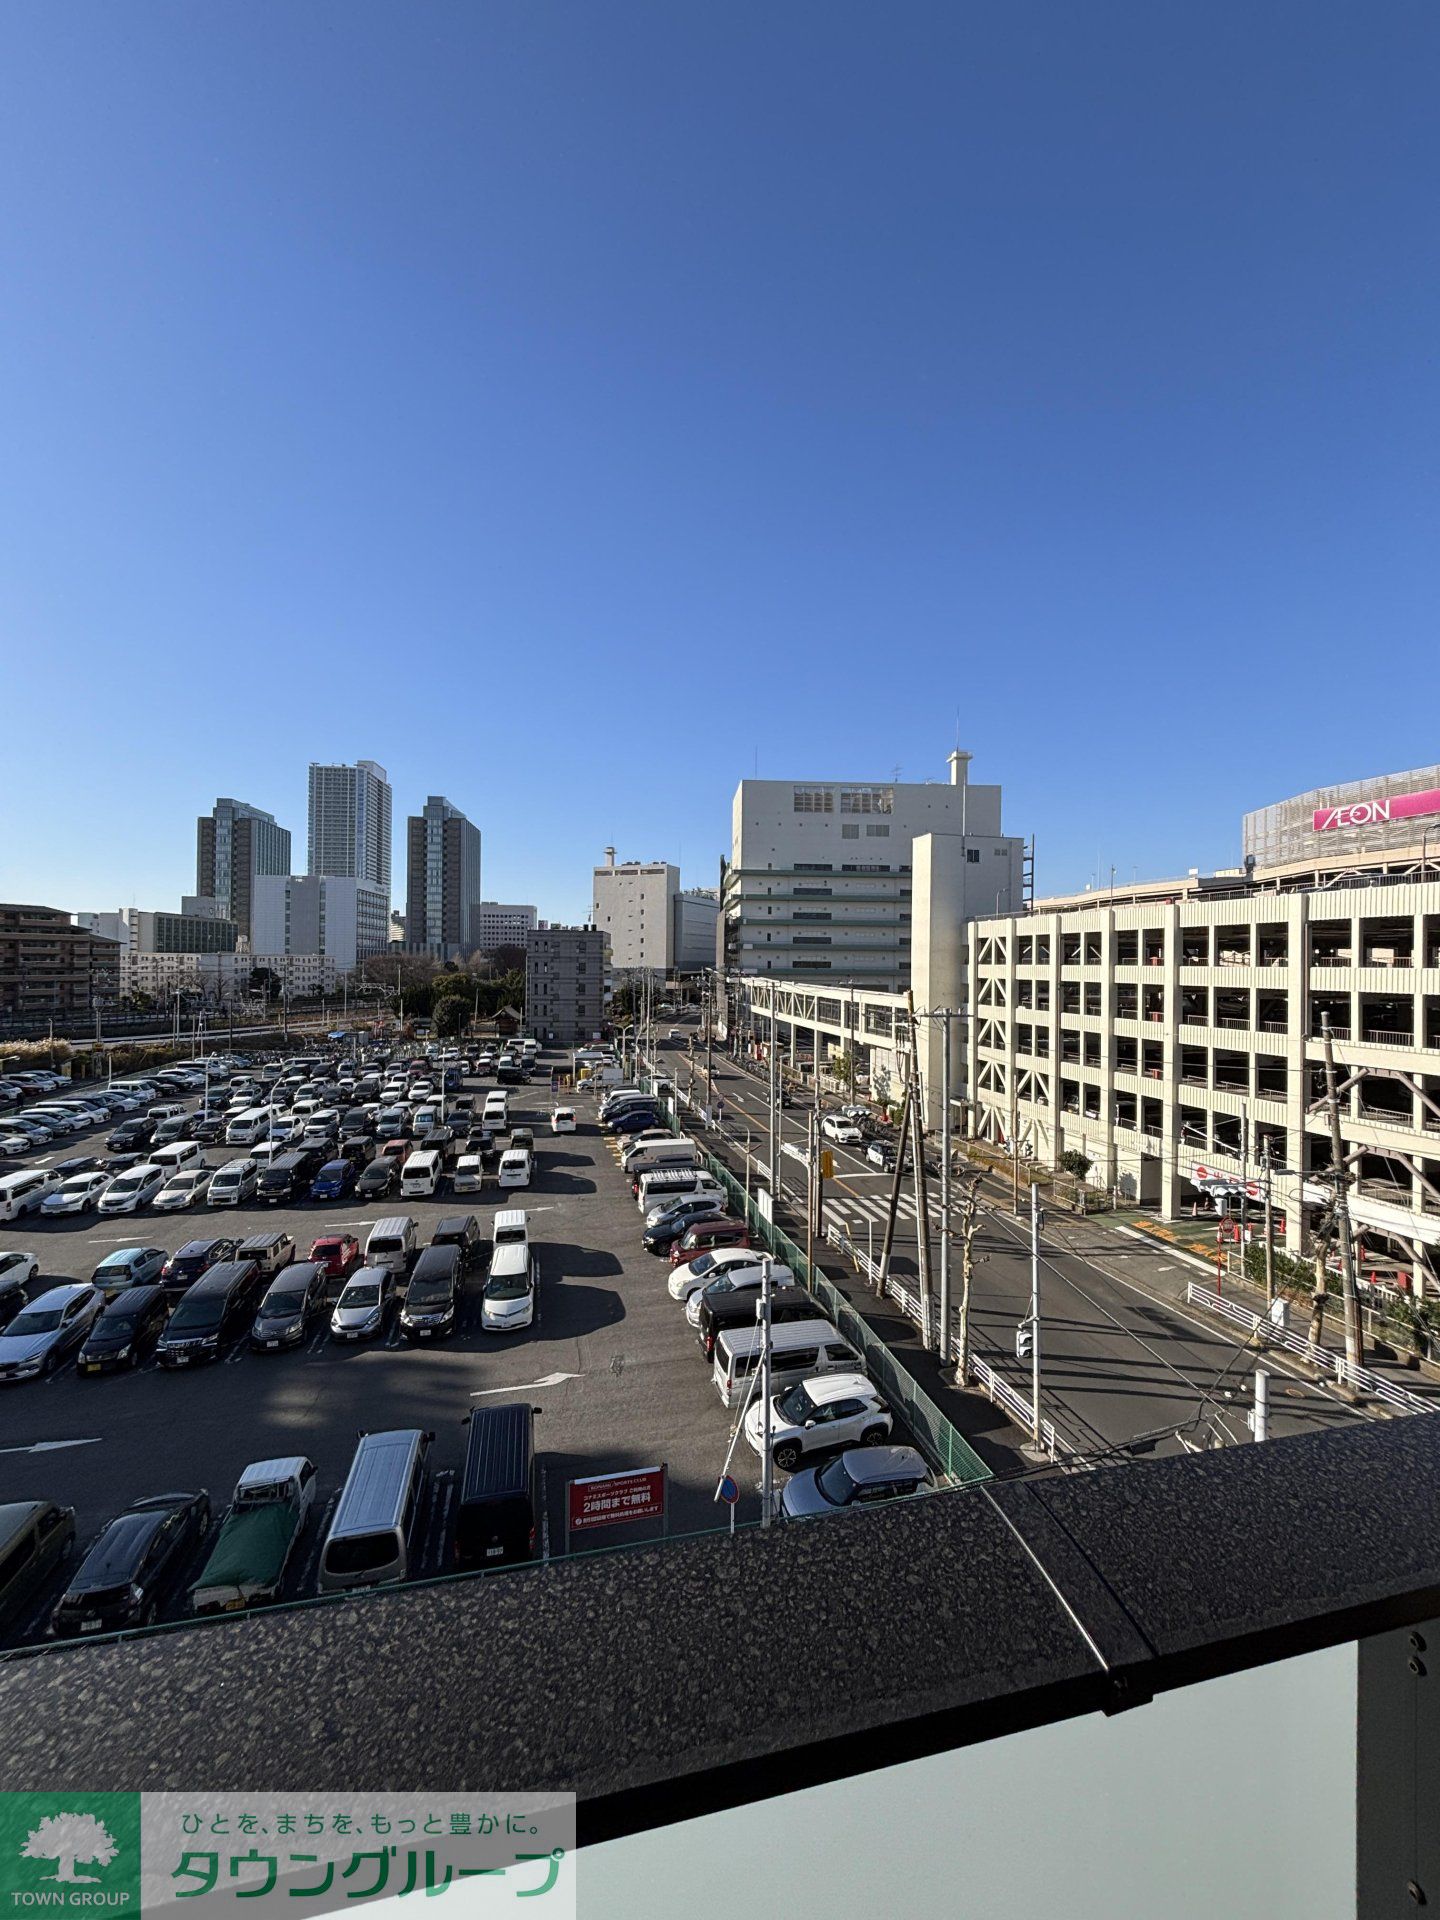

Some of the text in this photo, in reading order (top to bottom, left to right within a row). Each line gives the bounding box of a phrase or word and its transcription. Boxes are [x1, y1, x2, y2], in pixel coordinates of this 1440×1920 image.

[583, 1492, 651, 1513] 2時間まで無料
